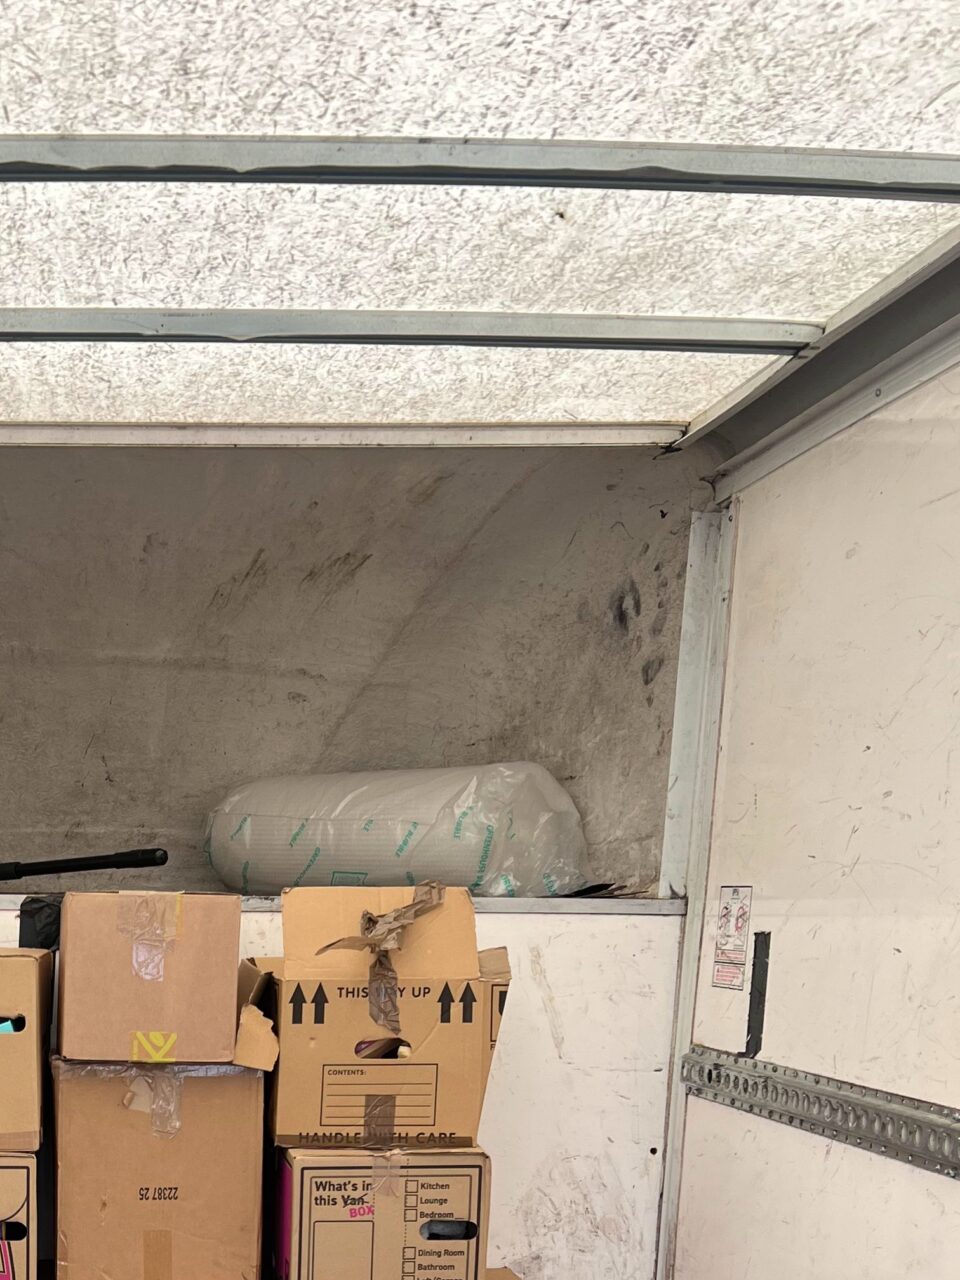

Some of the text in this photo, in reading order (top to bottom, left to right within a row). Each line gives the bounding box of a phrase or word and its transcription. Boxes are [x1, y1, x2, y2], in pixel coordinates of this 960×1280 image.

[337, 987, 369, 999] THIS
[411, 986, 431, 998] UP
[298, 1132, 457, 1144] HANDLE CARE
[314, 1180, 358, 1192] What's
[420, 1182, 450, 1190] Kitchen
[138, 1187, 179, 1201] 22387 25
[314, 1195, 367, 1208] this Van
[419, 1197, 448, 1205] Lounge
[348, 1205, 375, 1219] BOX
[419, 1211, 454, 1219] Bedroom
[418, 1249, 465, 1258] Dining Room
[417, 1263, 455, 1271] Bathroom
